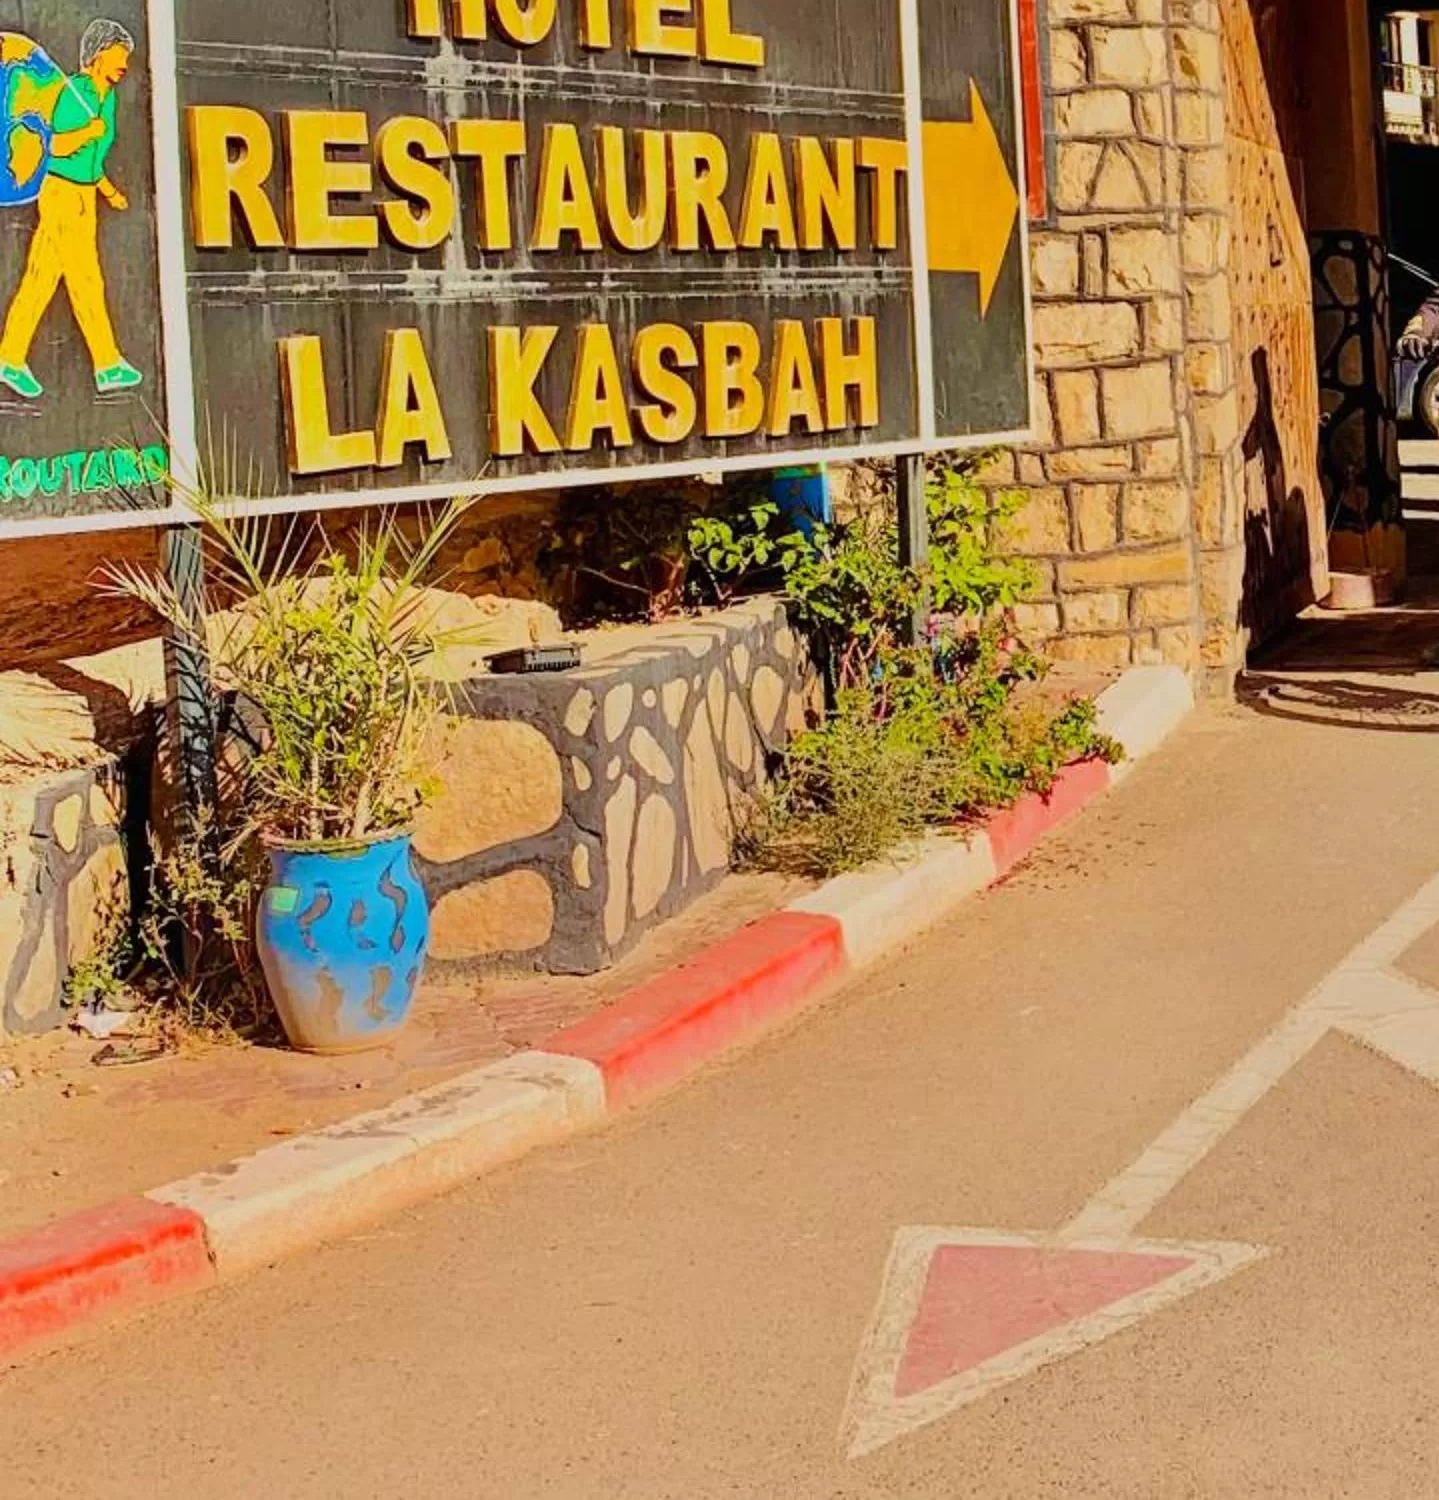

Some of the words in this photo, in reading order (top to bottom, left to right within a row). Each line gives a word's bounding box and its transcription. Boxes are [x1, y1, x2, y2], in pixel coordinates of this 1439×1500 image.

[187, 105, 909, 252] RESTAURANT
[276, 327, 452, 476] LA
[488, 315, 880, 459] KASBAH
